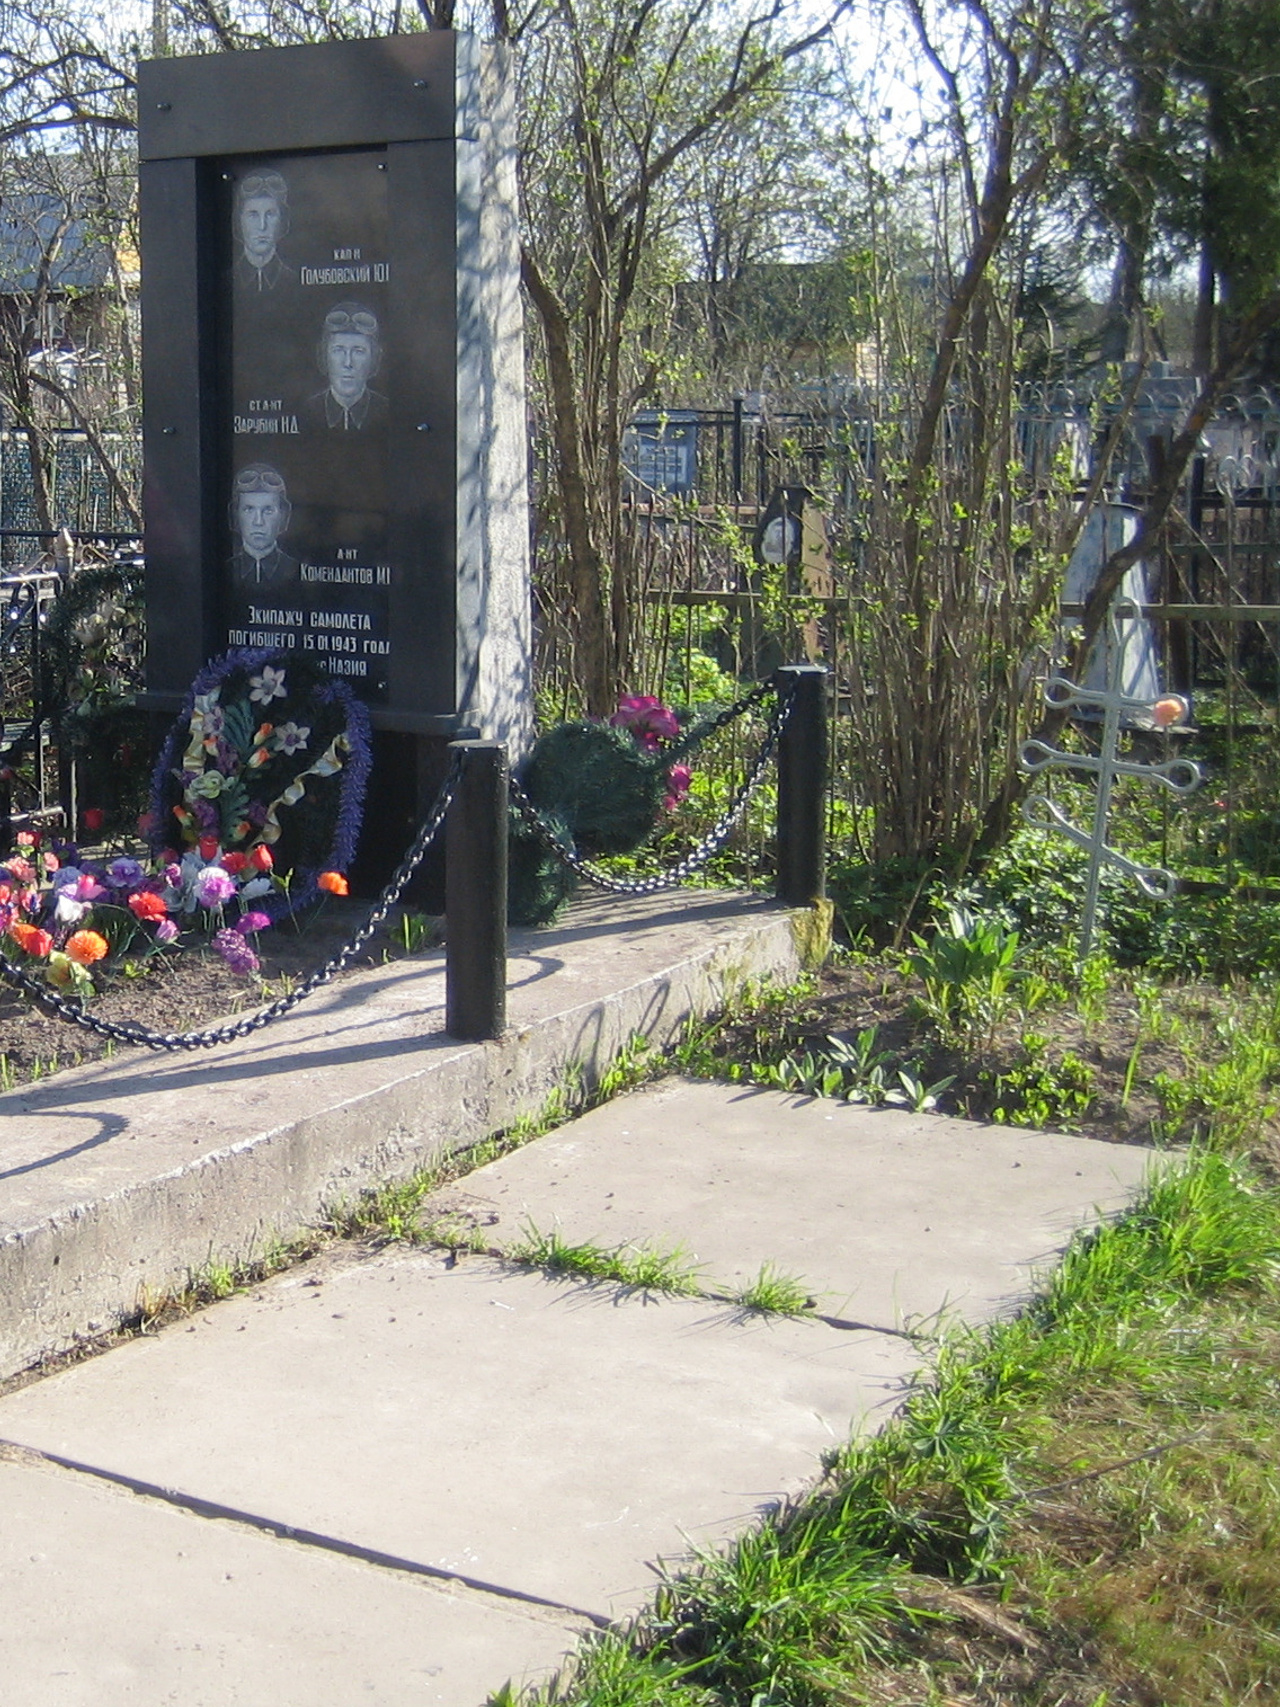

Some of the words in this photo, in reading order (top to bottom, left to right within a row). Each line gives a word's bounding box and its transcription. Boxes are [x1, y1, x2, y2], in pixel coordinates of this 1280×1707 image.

[248, 605, 303, 627] ЭКИПАЖУ
[310, 611, 372, 630] САМОЛЕТА
[228, 629, 295, 648] ПОГИБШЕГО
